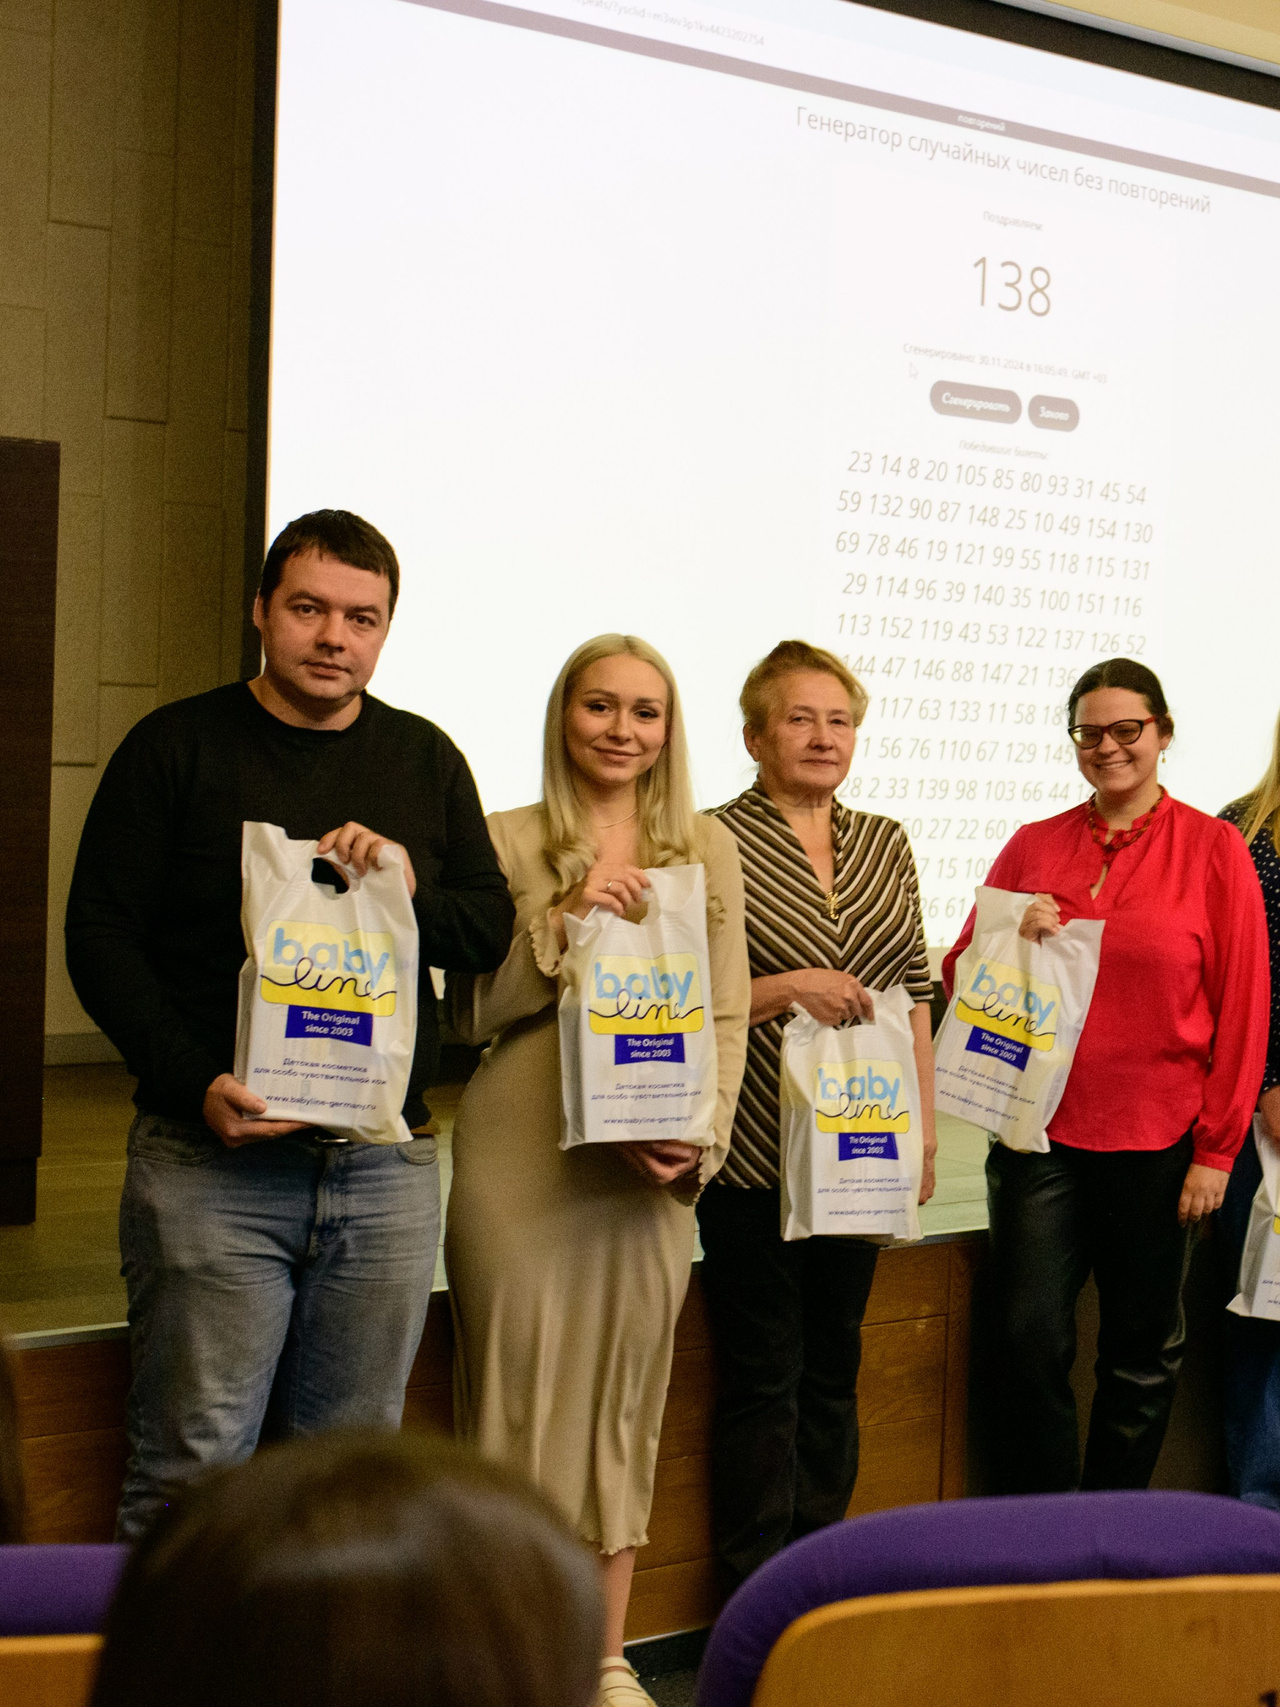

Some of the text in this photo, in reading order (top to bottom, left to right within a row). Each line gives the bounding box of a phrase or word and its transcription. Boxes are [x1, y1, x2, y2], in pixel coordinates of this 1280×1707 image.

[796, 106, 1211, 214] Генератор случайных чисел без повторений
[973, 256, 1051, 317] 138
[1072, 370, 1091, 381] GMT
[846, 449, 1147, 505] 23 14 8 20 105 85 80 93 31 45 54
[836, 489, 1154, 544] 59 132 90 87 148 25 10 49 154 130
[835, 529, 1151, 580] 69 78 46 19 121 99 55 118 115 131
[841, 571, 1143, 618] 29 114 96 39 140 35 100 151 116
[838, 611, 1147, 656] 113 152 119 43 53 122 137 126 52
[841, 653, 1077, 689] 144 47 146 88 147 21 136
[880, 696, 914, 719] 117
[917, 697, 943, 721] 63
[949, 699, 982, 723] 133
[988, 701, 1008, 724] 11
[1013, 702, 1037, 725] 58
[878, 736, 903, 760] 56
[908, 737, 931, 761] 76
[939, 738, 972, 762] 110
[975, 740, 1000, 762] 67
[1006, 741, 1038, 764] 129
[1044, 743, 1075, 765] 145
[867, 776, 881, 799] 2
[885, 776, 911, 800] 33
[917, 777, 951, 801] 139
[954, 778, 979, 801] 98
[985, 779, 1017, 802] 103
[1020, 780, 1044, 802] 66
[1047, 781, 1071, 801] 44
[926, 817, 952, 840] 27
[955, 817, 980, 840] 22
[983, 818, 1008, 840] 60
[937, 856, 958, 880] 15
[944, 896, 966, 919] 61
[272, 927, 390, 989] baby
[595, 962, 694, 1008] baby
[301, 1010, 360, 1026] The Original
[304, 1024, 354, 1037] since 2003
[627, 1037, 675, 1048] The Original
[630, 1049, 671, 1059] since 2003
[980, 1044, 1017, 1061] since 2003
[981, 1032, 1024, 1054] The Original
[818, 1066, 900, 1110] baby
